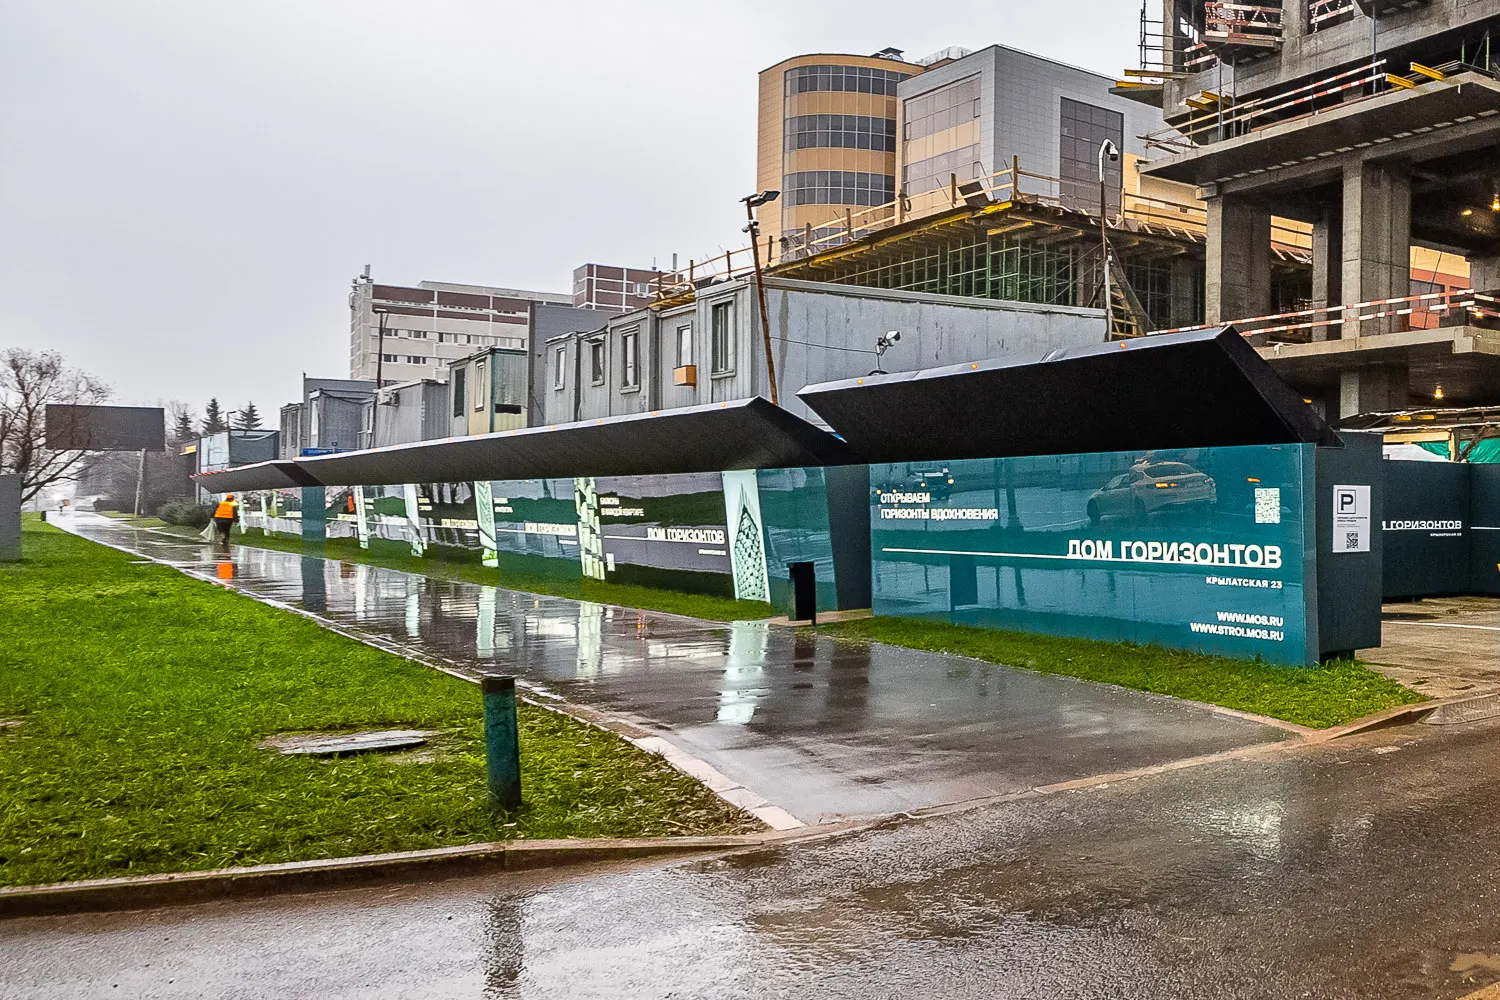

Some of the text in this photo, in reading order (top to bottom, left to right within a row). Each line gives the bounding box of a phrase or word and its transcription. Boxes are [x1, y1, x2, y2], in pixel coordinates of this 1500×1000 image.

[880, 493, 931, 504] ОТКРЫВАЕМ
[1340, 493, 1354, 511] P
[880, 508, 999, 521] ГОРИЗОНТЫ ВДОХНОВЕНИЯ
[1390, 520, 1462, 530] ГОРИЗОНТОВ
[647, 527, 726, 545] ДОМ ГОРИЗОНТОВ
[1066, 539, 1283, 569] ДОМ ГОРИЗОНТОВ
[1206, 576, 1283, 590] КРЫЛАТСКАЯ 23
[1216, 611, 1284, 627] WWW.MOS.RU
[1190, 622, 1284, 641] WWW.STROI.MOS.RU
